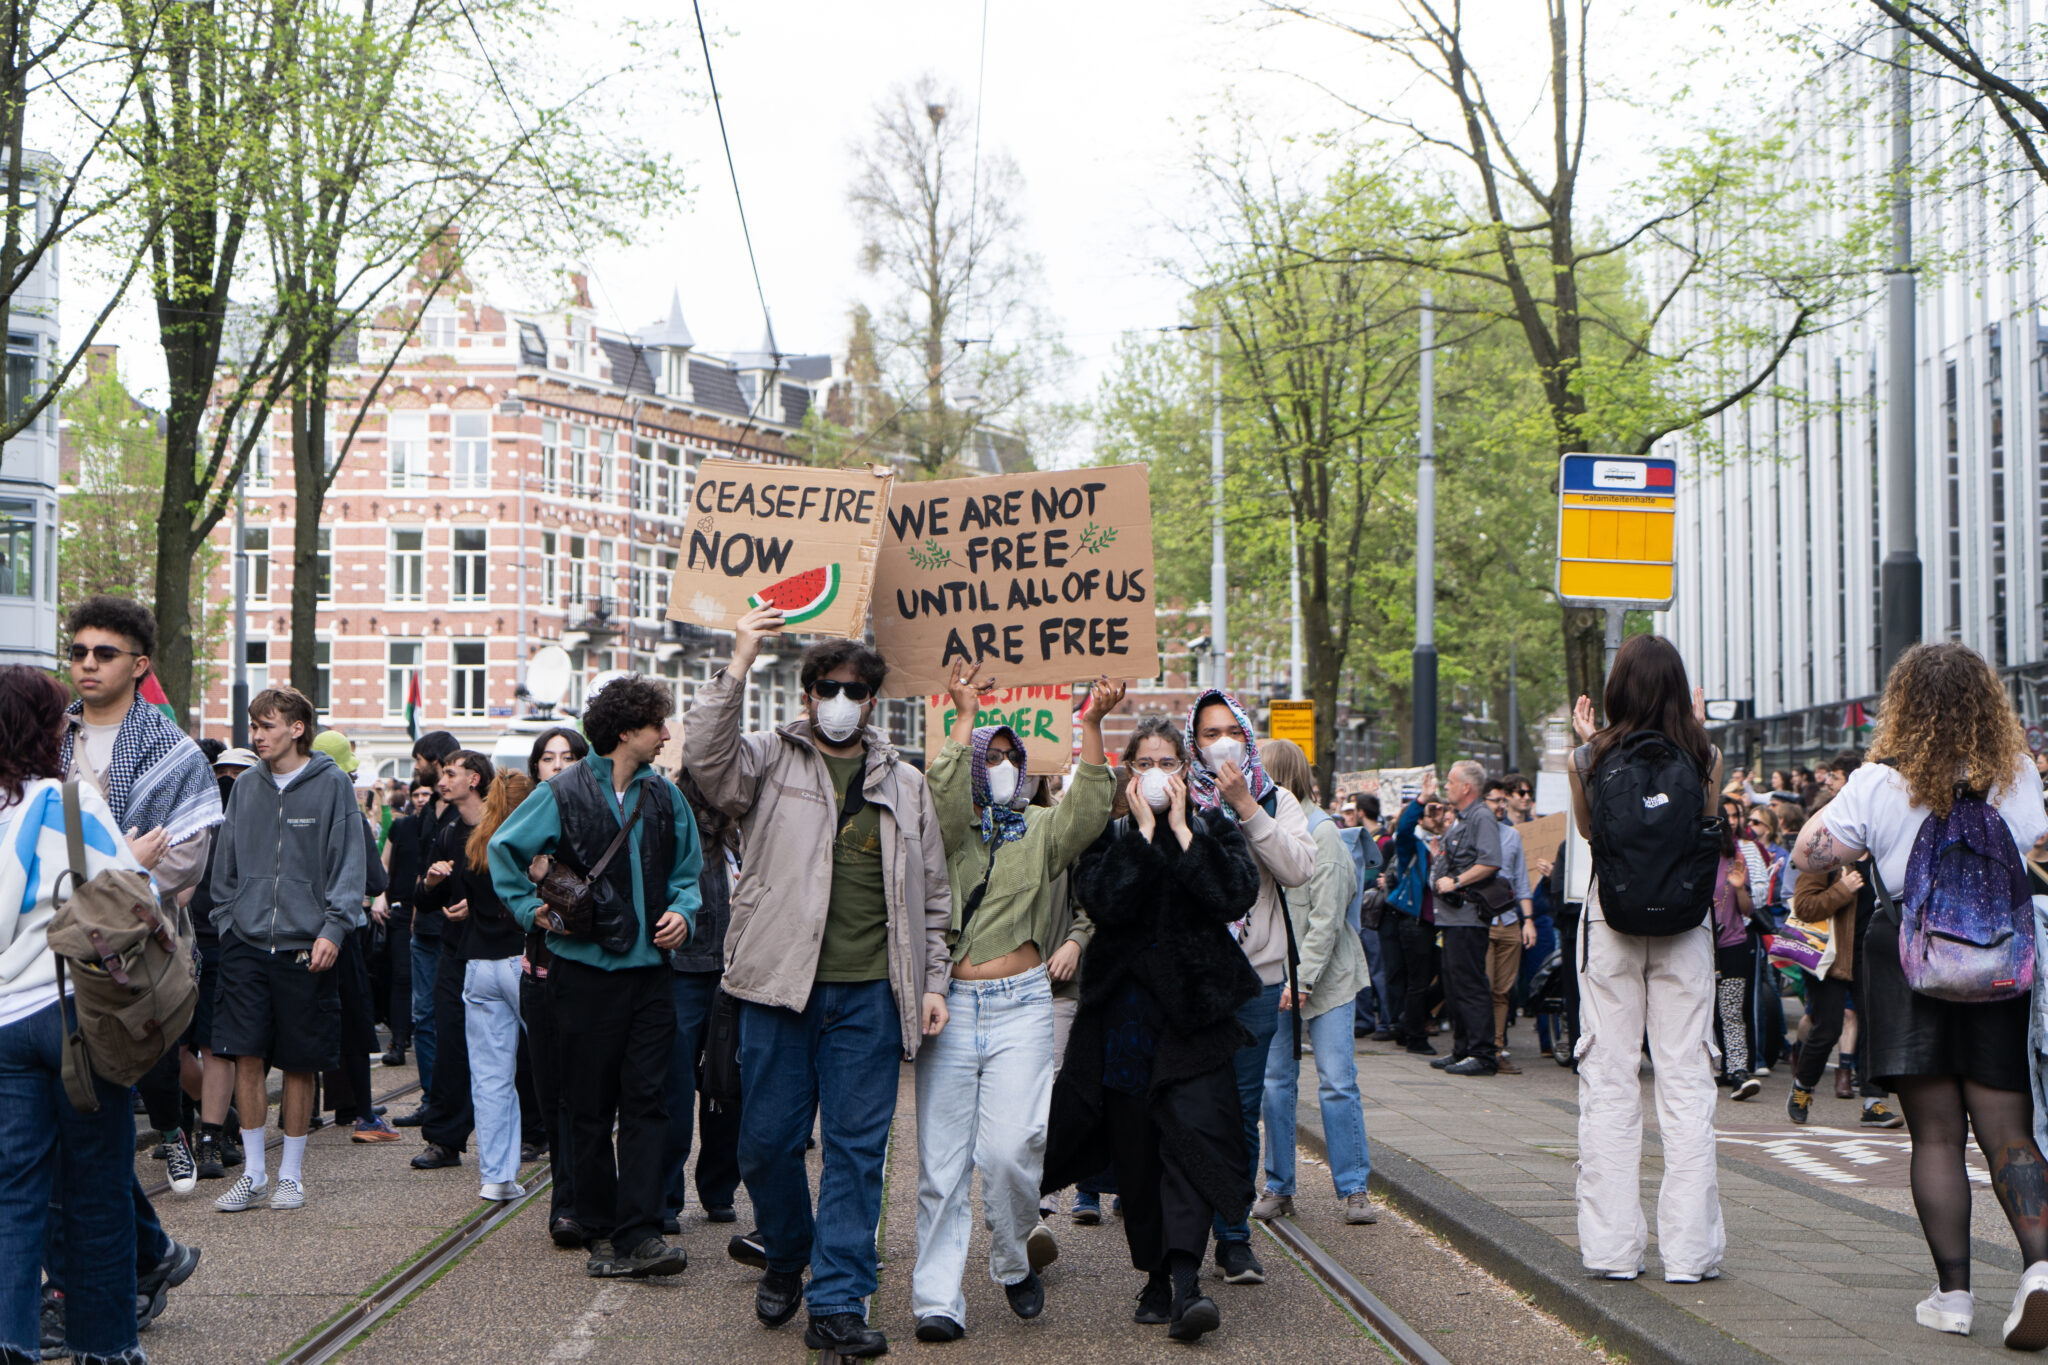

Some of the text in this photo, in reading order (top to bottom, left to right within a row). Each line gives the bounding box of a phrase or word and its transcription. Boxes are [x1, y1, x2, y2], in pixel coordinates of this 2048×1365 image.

[696, 480, 875, 523] CEASEFIRE
[887, 483, 1106, 542] WE ARE NOT
[1582, 494, 1656, 504] Calamiteitenhalte
[688, 529, 794, 577] NOW
[967, 529, 1069, 574] FREE
[897, 569, 1146, 619] UNTIL ALL OF US
[942, 618, 1129, 667] ARE FREE
[944, 707, 1059, 743] FREVER
